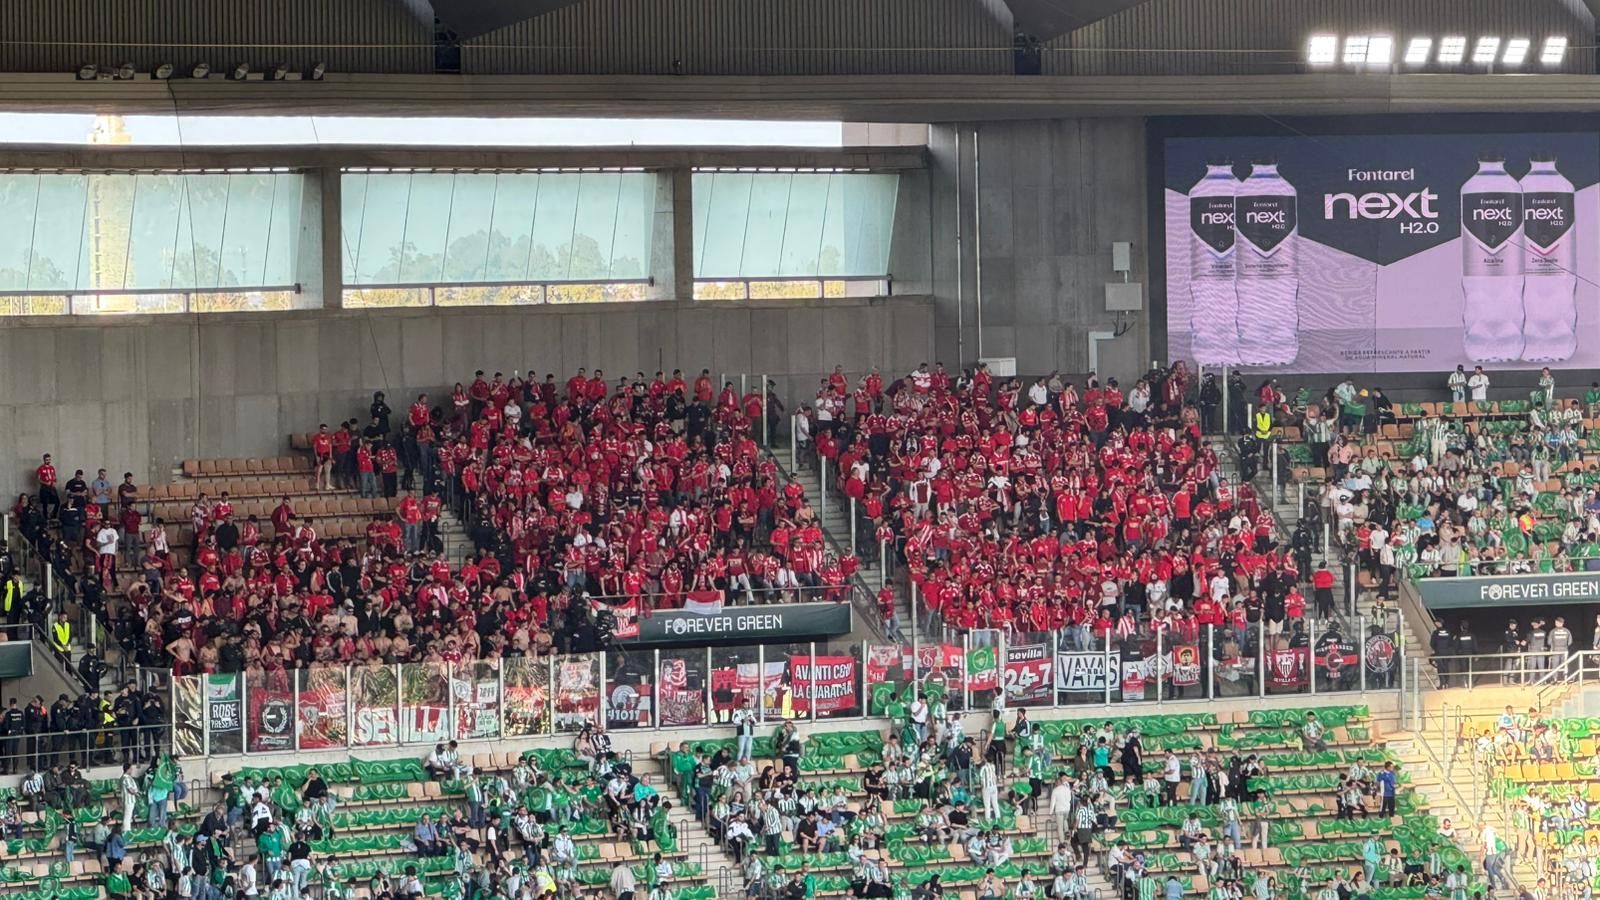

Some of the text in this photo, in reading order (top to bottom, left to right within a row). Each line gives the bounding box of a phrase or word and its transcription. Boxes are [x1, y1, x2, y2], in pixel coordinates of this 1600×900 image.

[1348, 168, 1415, 181] Fontarel
[1324, 187, 1439, 220] next
[1200, 212, 1234, 225] nex
[1246, 210, 1286, 223] next
[1473, 207, 1513, 221] next
[1525, 207, 1564, 220] next
[1480, 580, 1598, 601] FOREVER GREEN
[664, 614, 783, 635] FOREVER GREEN
[1009, 649, 1042, 660] sevilla
[1060, 656, 1118, 686] VAYAS
[793, 684, 804, 699] LA
[212, 703, 237, 719] ROBE
[608, 709, 640, 721] 41011
[358, 705, 449, 743] SEVILLA
